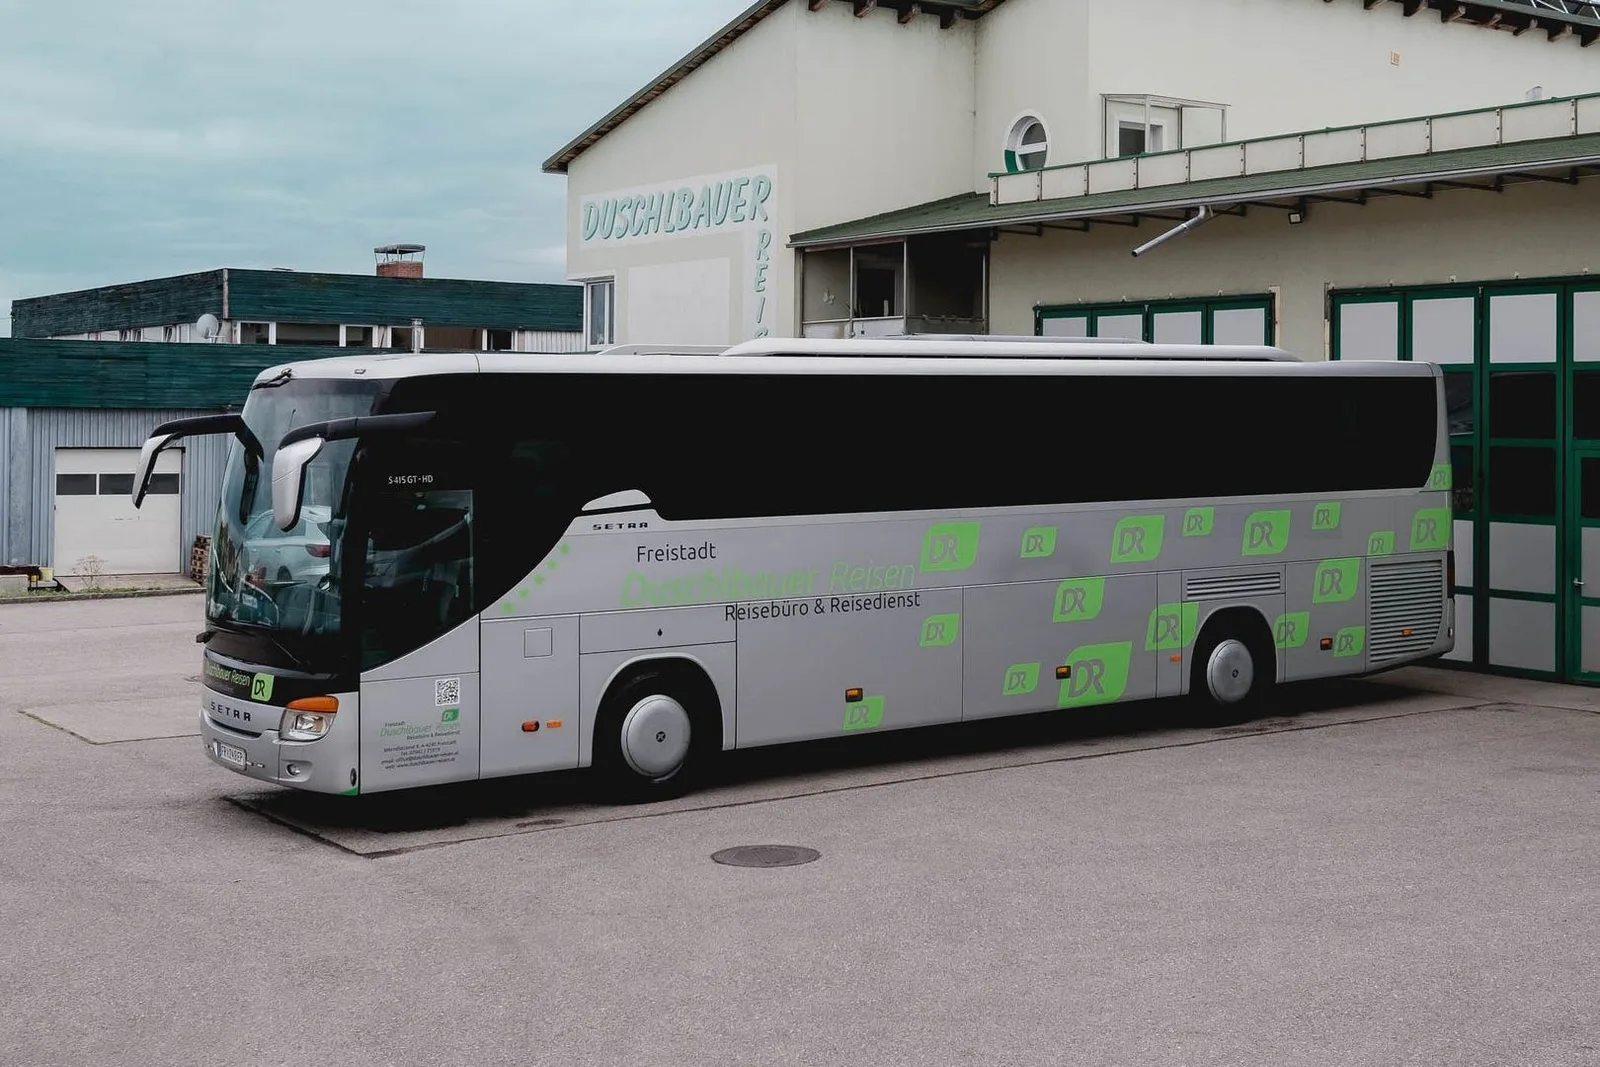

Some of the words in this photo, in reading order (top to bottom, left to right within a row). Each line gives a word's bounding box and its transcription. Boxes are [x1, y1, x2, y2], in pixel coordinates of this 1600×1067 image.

[583, 174, 771, 241] DUSCHLBAUER
[592, 522, 648, 530] SETRA
[637, 541, 717, 562] Freistadt
[620, 567, 816, 607] Duschlbauer
[830, 560, 915, 592] Reisen
[725, 600, 809, 621] Reisebüro
[814, 598, 825, 615] &
[830, 592, 920, 612] Reisedienst
[254, 679, 266, 697] DR
[210, 701, 251, 721] SETRA
